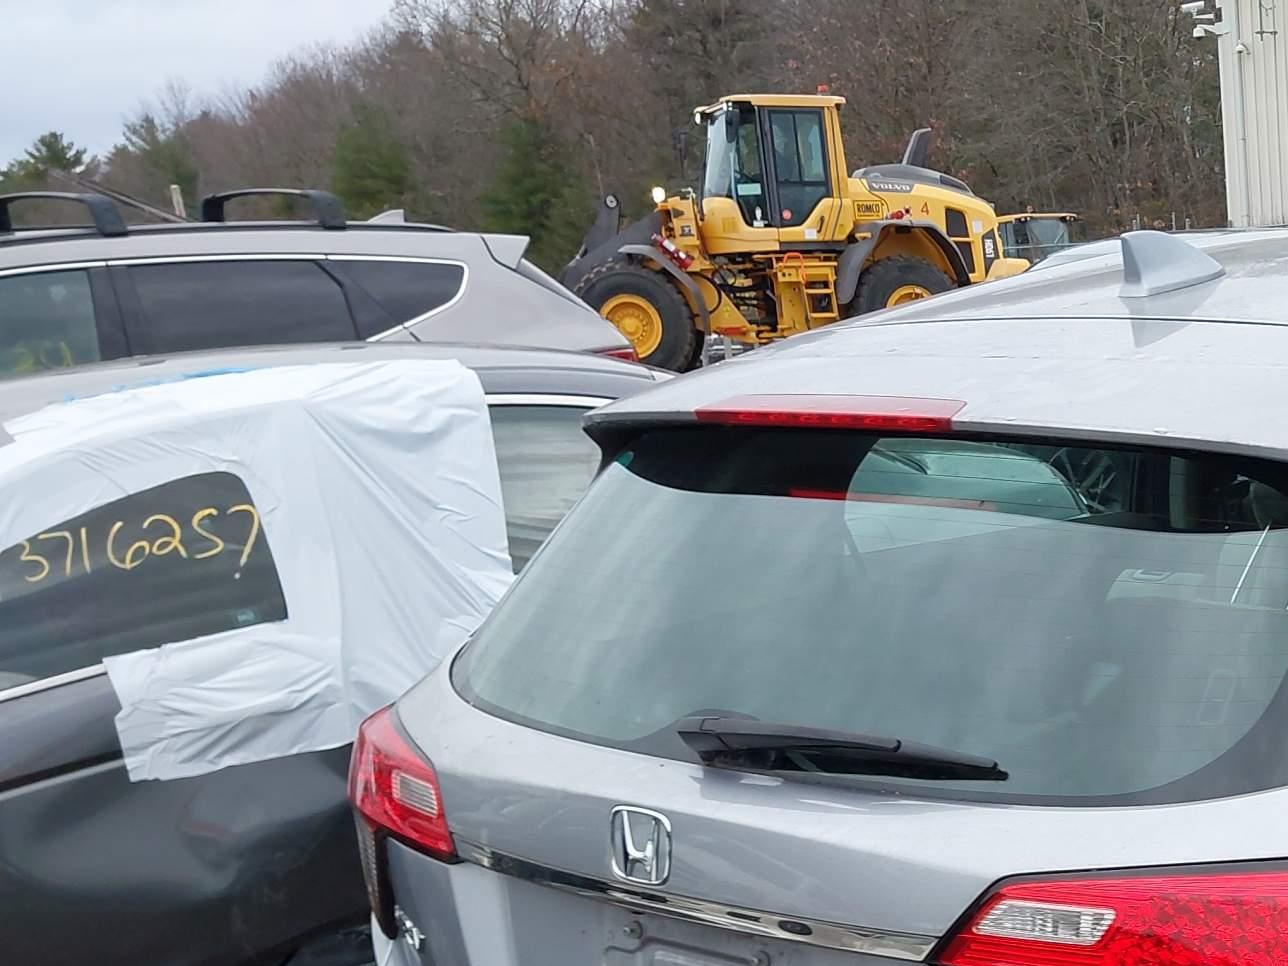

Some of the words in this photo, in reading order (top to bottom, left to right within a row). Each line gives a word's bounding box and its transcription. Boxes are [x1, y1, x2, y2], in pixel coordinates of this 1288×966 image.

[871, 182, 911, 191] VOLVO
[856, 203, 881, 214] ROMCO
[920, 201, 930, 216] 4
[20, 504, 260, 582] 3716257
